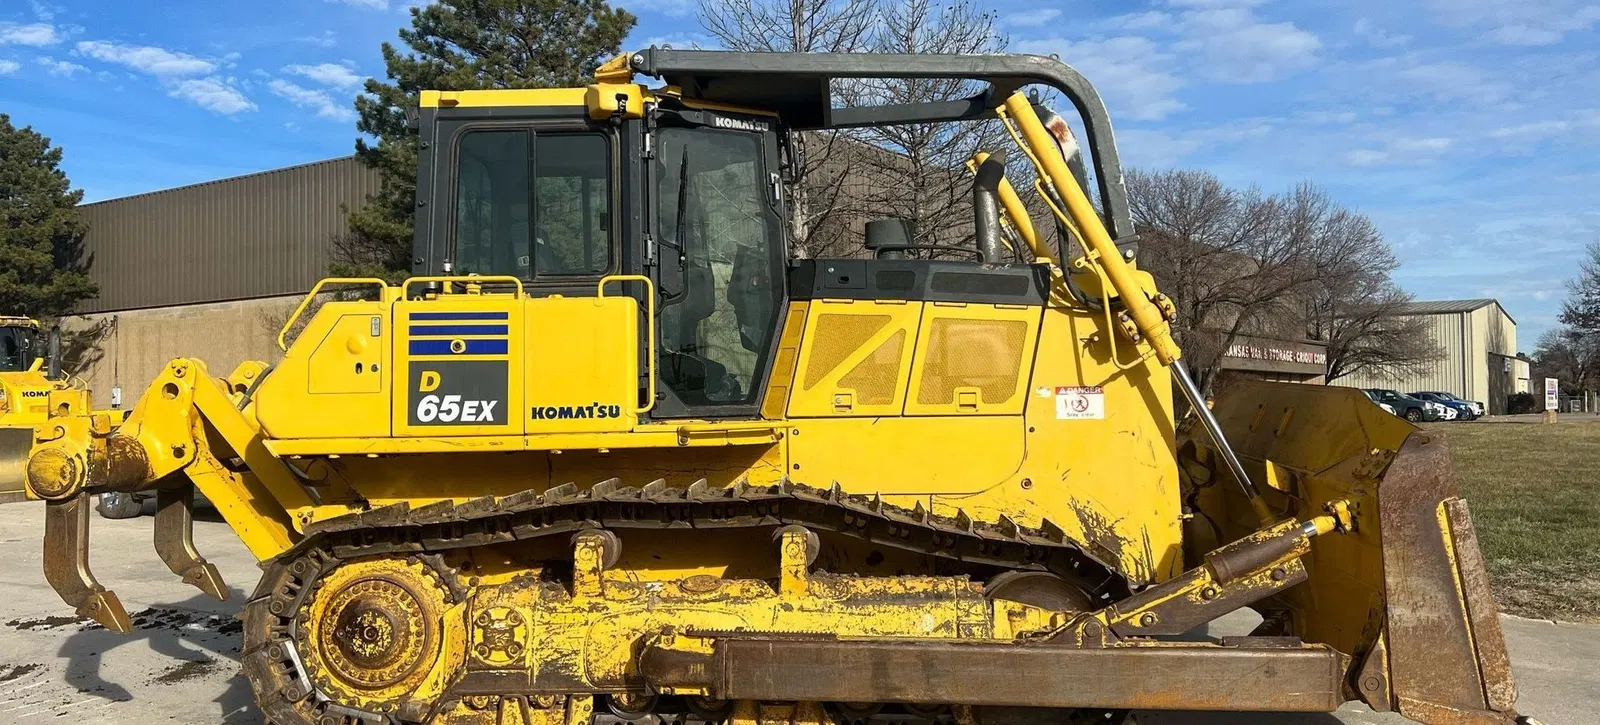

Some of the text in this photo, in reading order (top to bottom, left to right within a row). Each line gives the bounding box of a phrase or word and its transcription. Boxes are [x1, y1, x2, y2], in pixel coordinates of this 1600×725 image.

[715, 117, 769, 132] KOMATSU
[1269, 348, 1293, 362] STORAGE
[419, 371, 441, 392] D
[1067, 386, 1101, 394] DANGER
[417, 394, 498, 422] 65EX
[531, 402, 620, 420] KOMATSU
